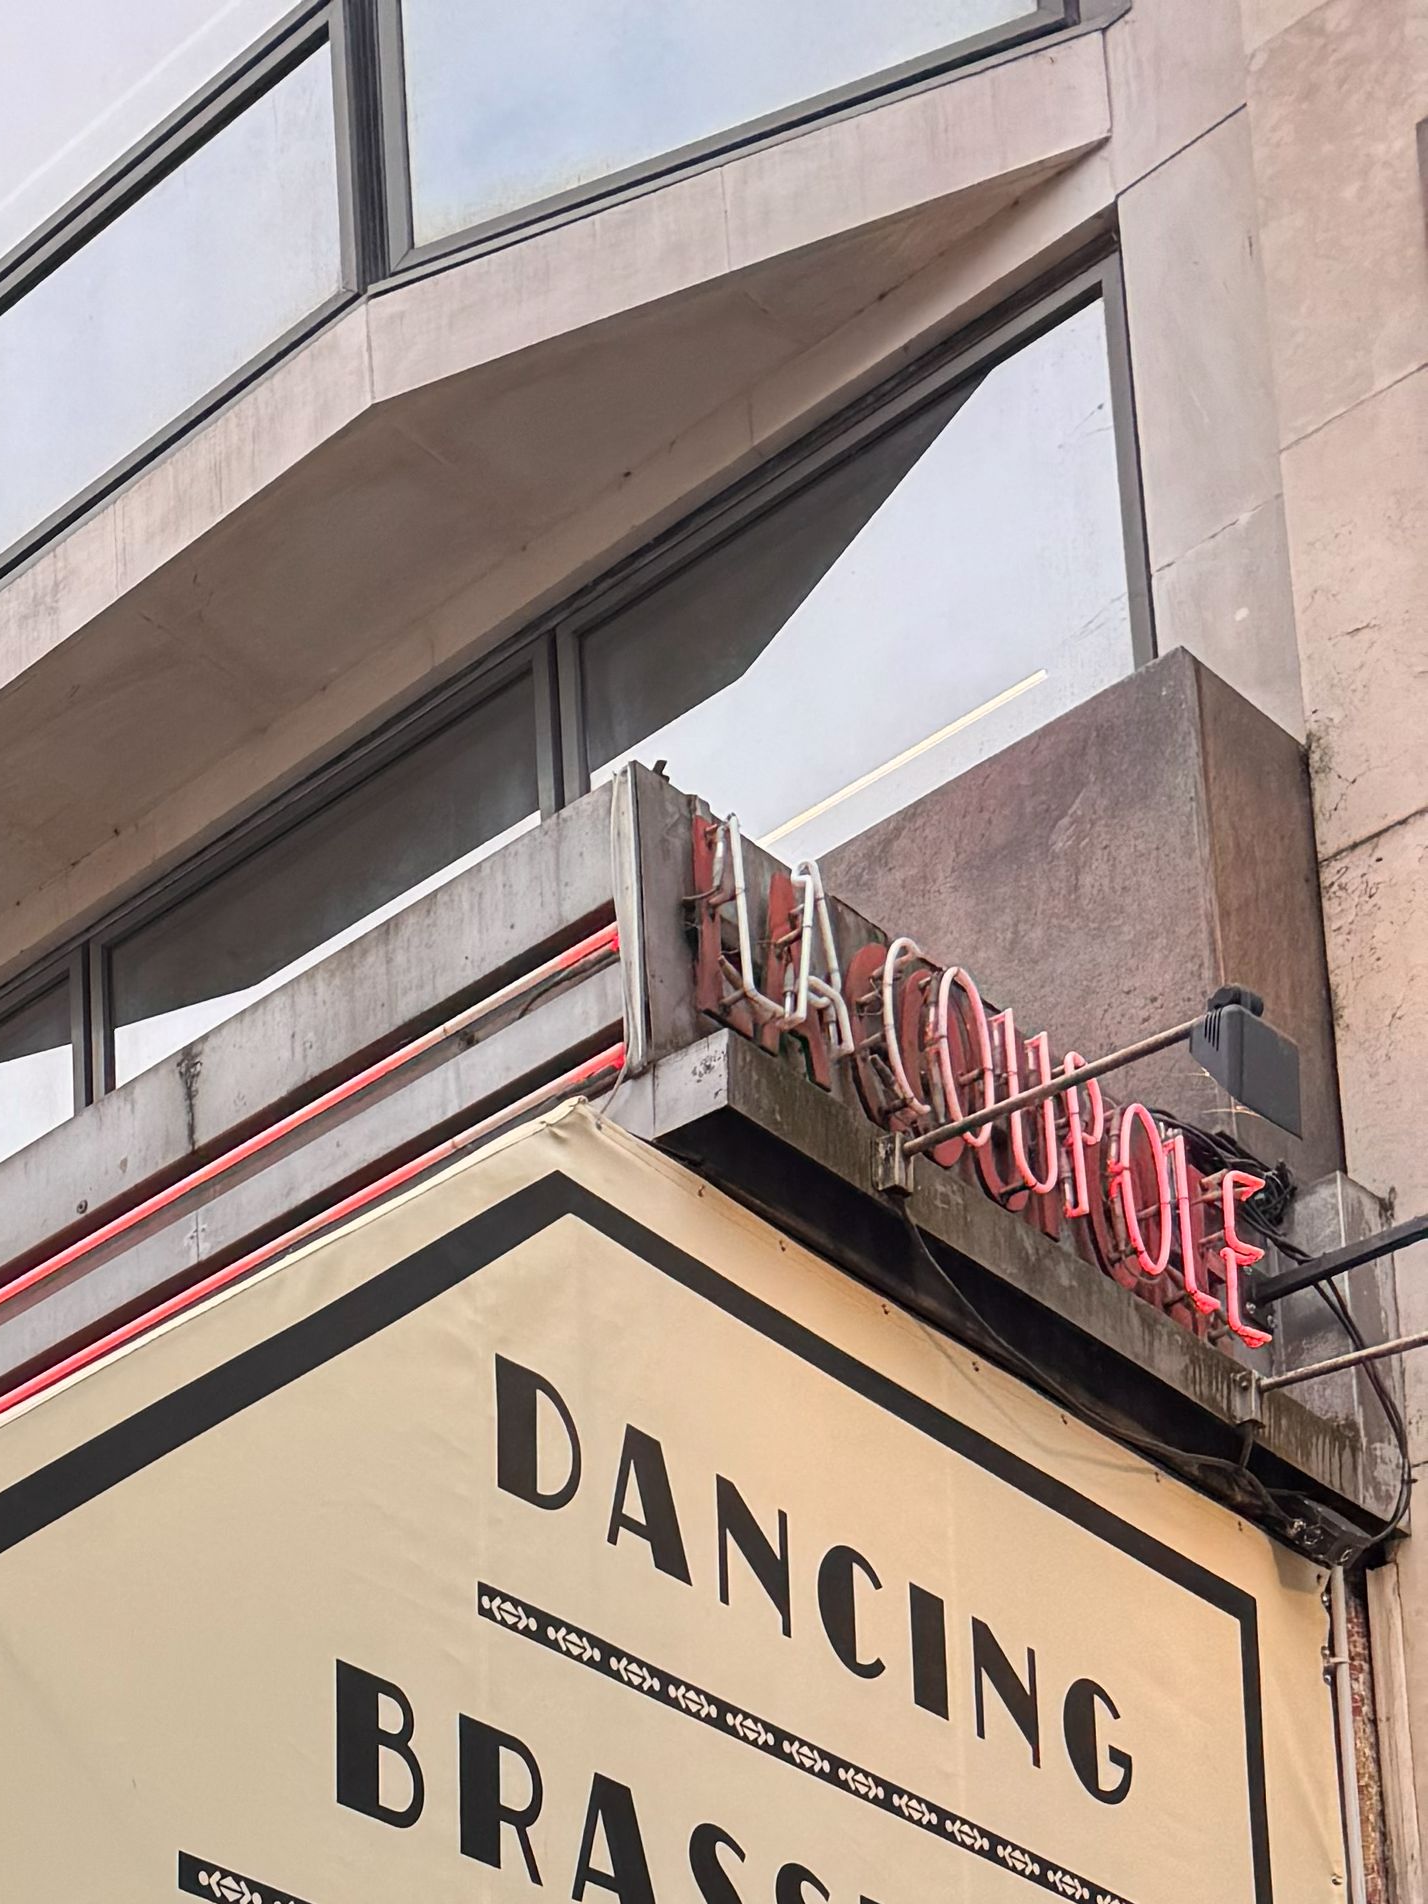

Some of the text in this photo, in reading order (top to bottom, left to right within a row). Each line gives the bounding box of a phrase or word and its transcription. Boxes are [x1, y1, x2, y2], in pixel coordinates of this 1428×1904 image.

[693, 813, 1274, 1350] LA COUPOLE
[494, 1353, 1133, 1806] DANCING
